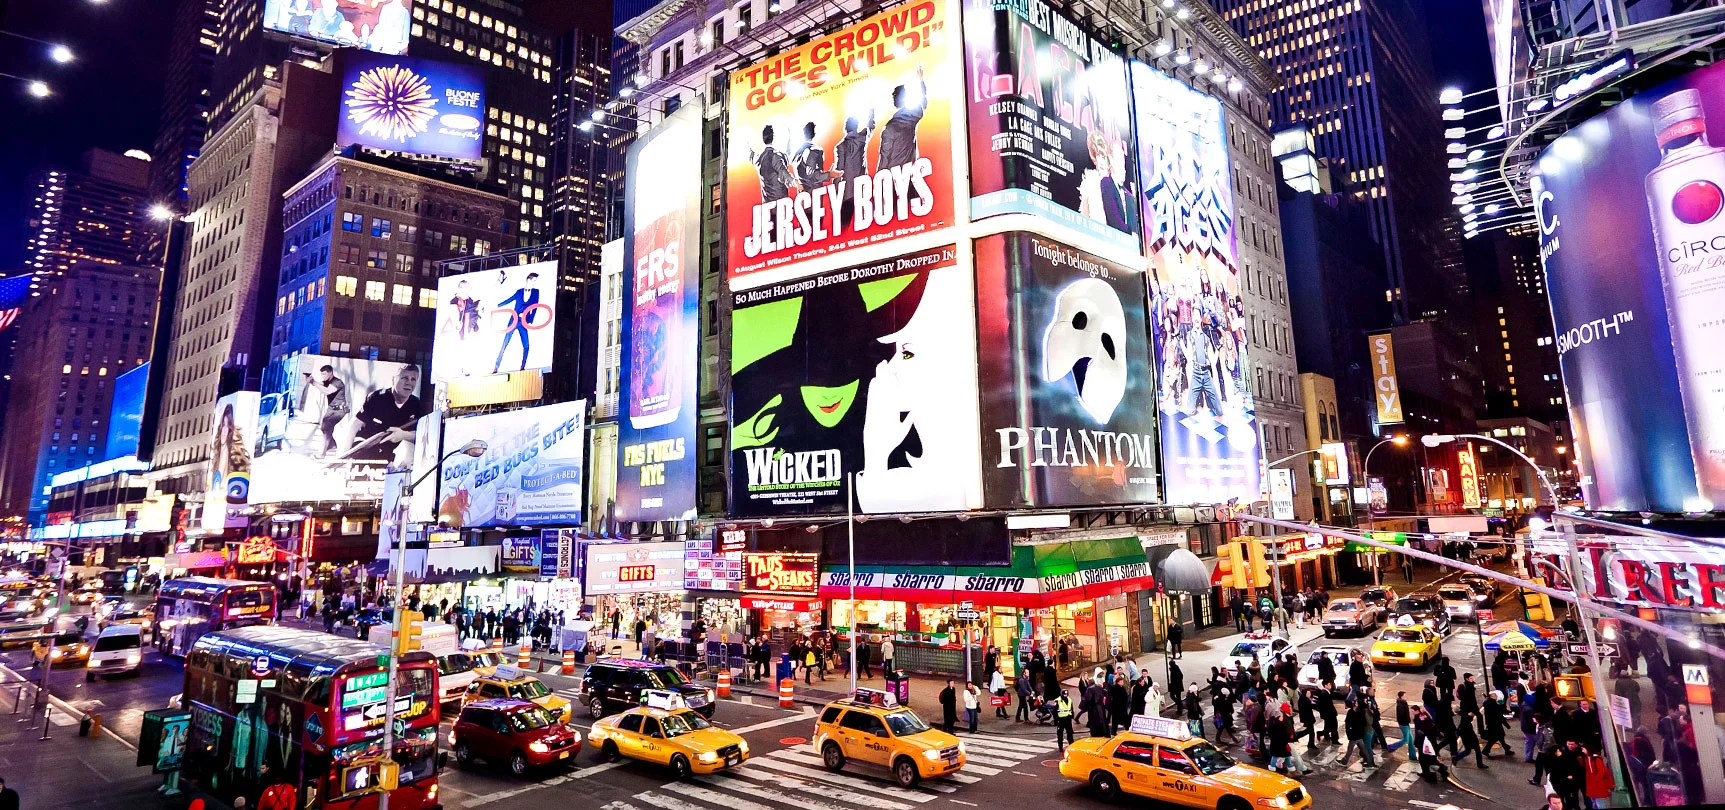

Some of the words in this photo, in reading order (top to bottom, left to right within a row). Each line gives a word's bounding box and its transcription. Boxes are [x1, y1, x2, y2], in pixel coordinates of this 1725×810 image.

[810, 1, 936, 65] CROWD
[1028, 1, 1051, 36] BEST
[1052, 10, 1090, 63] MUSICAL
[445, 88, 480, 100] BUONE
[812, 87, 829, 97] New
[830, 82, 846, 92] York
[847, 74, 870, 86] Times
[447, 97, 479, 109] FESTE.
[989, 101, 1015, 117] KELSEY
[1008, 117, 1018, 130] LA
[744, 180, 847, 258] JERSEY
[853, 157, 934, 232] BOYS
[767, 255, 792, 267] Wilson
[848, 237, 869, 247] West
[871, 231, 894, 243] 52nd
[895, 224, 925, 237] Street
[636, 241, 680, 294] FRS
[1032, 238, 1067, 266] Tonight
[1067, 249, 1098, 278] belongs
[1375, 338, 1399, 414] stay.
[543, 412, 580, 451] BITE!
[624, 443, 646, 467] FRS
[646, 437, 686, 464] FUELS
[995, 426, 1153, 468] PHANTOM
[444, 459, 479, 481] DON'T
[475, 465, 500, 489] BED
[504, 441, 539, 475] BUGS
[641, 462, 665, 487] NYC
[1458, 451, 1477, 504] PARK
[509, 545, 536, 560] GIFTS
[620, 565, 654, 581] GIFTS
[769, 570, 814, 591] STEAKS
[893, 570, 945, 589] sbarro
[1084, 567, 1114, 585] sbarro
[1120, 562, 1147, 580] sbarro
[964, 572, 1025, 593] sbarro
[1044, 572, 1077, 593] sbarro
[365, 674, 378, 686] 47
[1156, 719, 1169, 728] EYES
